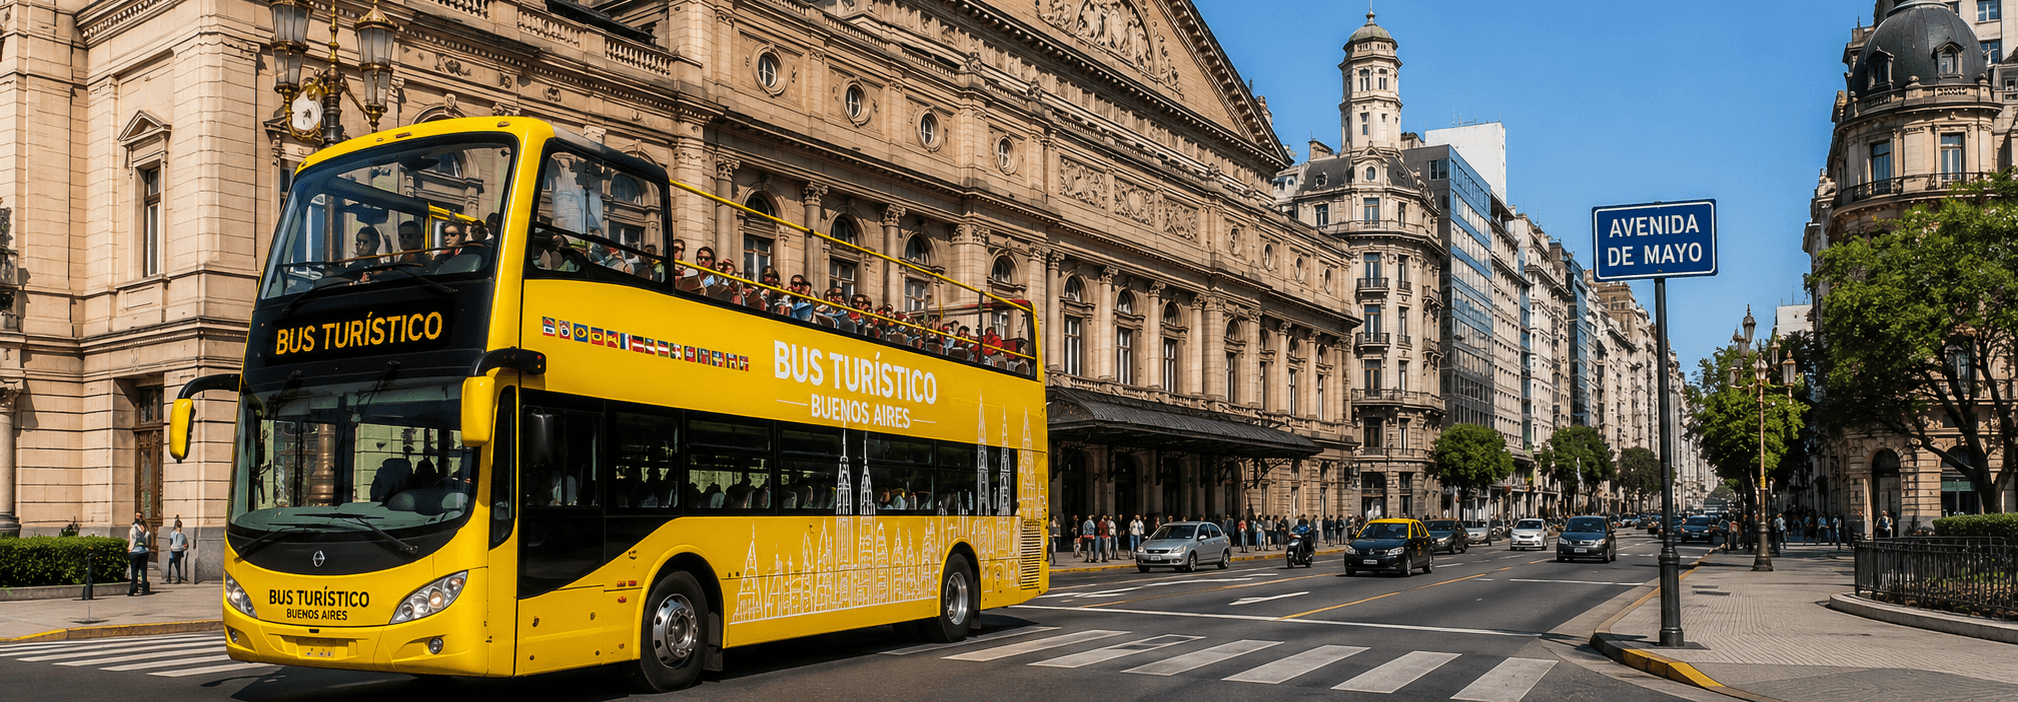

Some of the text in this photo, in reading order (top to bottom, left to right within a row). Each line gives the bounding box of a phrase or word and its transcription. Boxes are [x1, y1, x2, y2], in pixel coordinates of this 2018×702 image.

[1608, 213, 1700, 238] AVENIDA
[1607, 242, 1703, 267] DE MAYO
[275, 311, 443, 355] BUS TURÍSTICO
[774, 339, 937, 405] BUS TURÍSTICO
[811, 393, 911, 429] BUENOS AIRES
[269, 586, 370, 607] BUS TURÍSTICO
[286, 608, 348, 621] BUENOS AIRES
